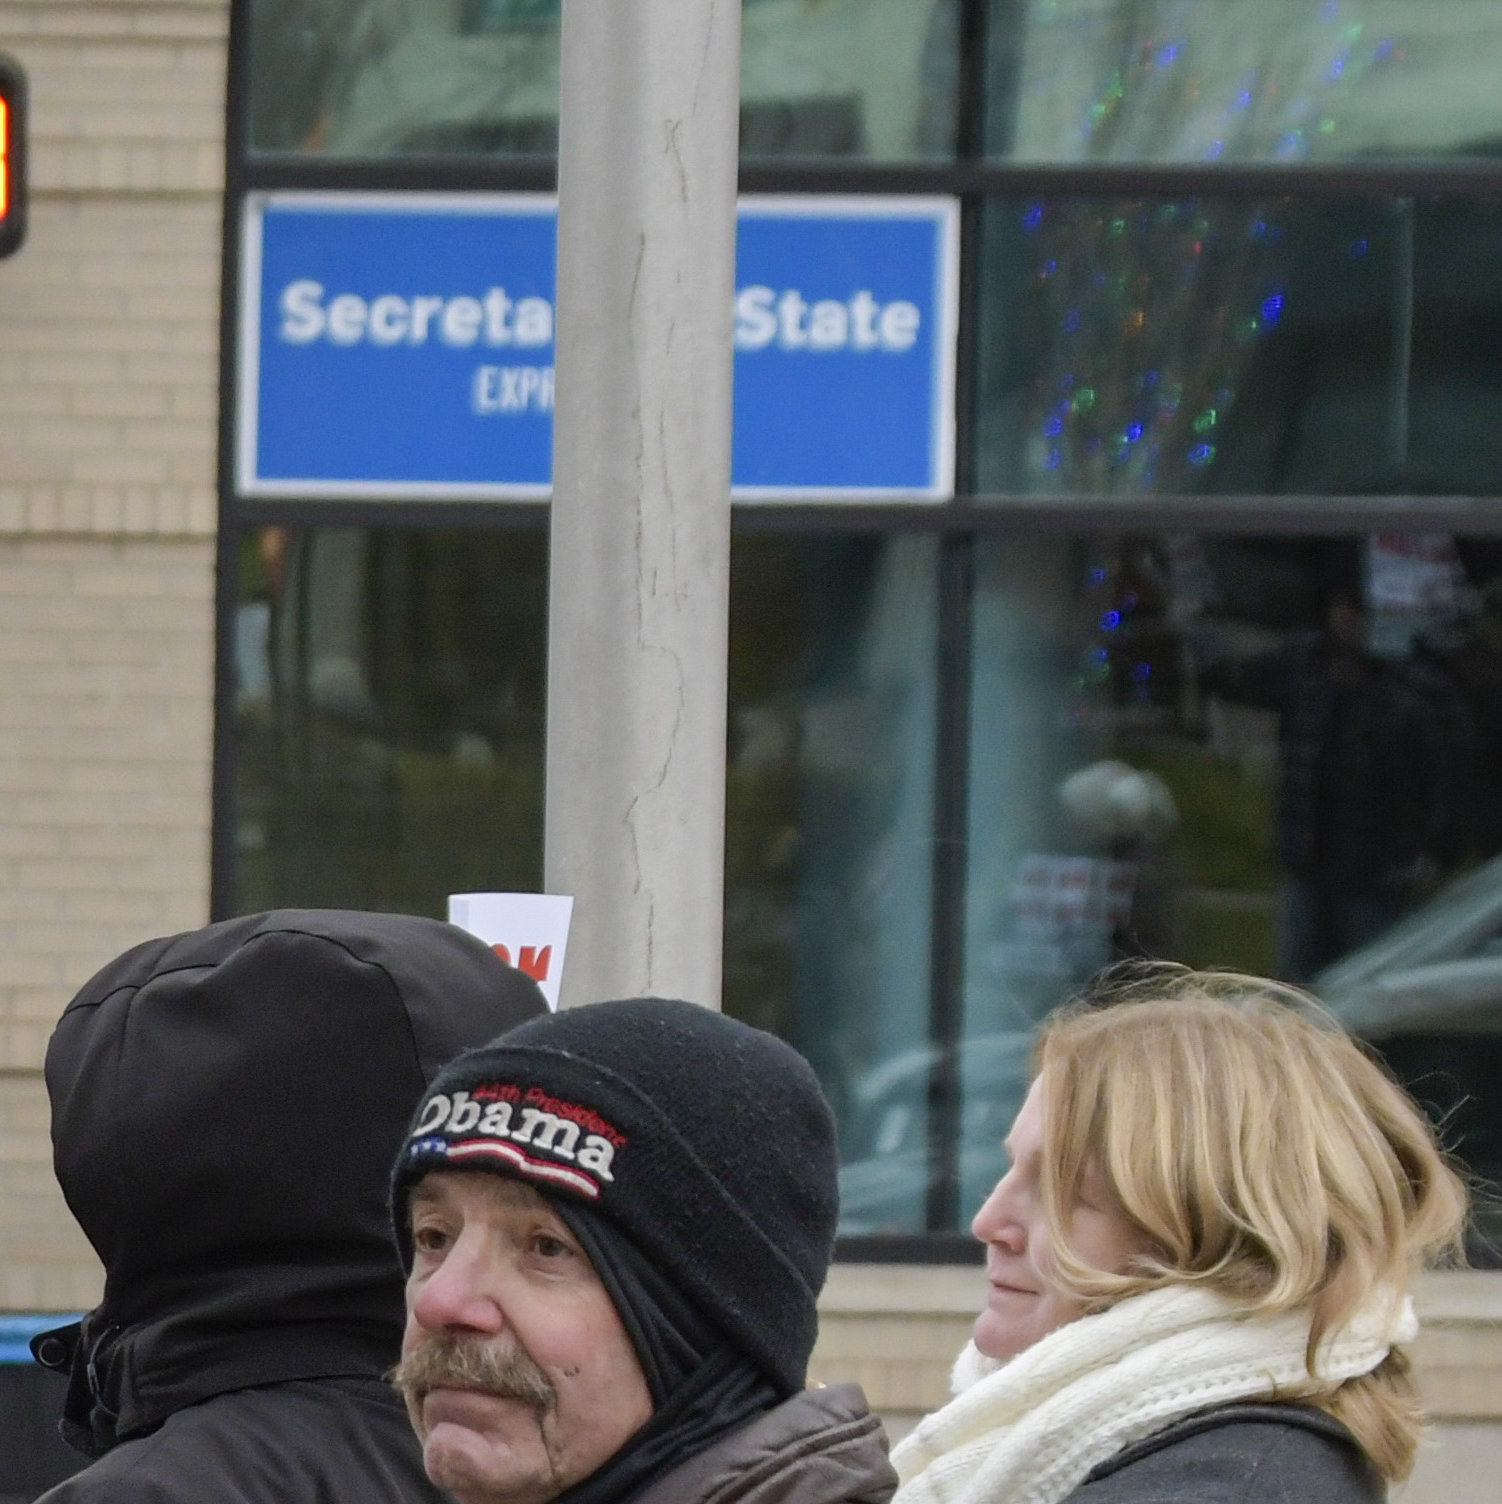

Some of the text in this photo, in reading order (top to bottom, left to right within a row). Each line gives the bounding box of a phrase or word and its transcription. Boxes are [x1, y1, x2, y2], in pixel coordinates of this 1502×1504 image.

[280, 279, 921, 350] Secreta State
[477, 365, 555, 412] EXPR
[413, 1091, 615, 1183] Obama
